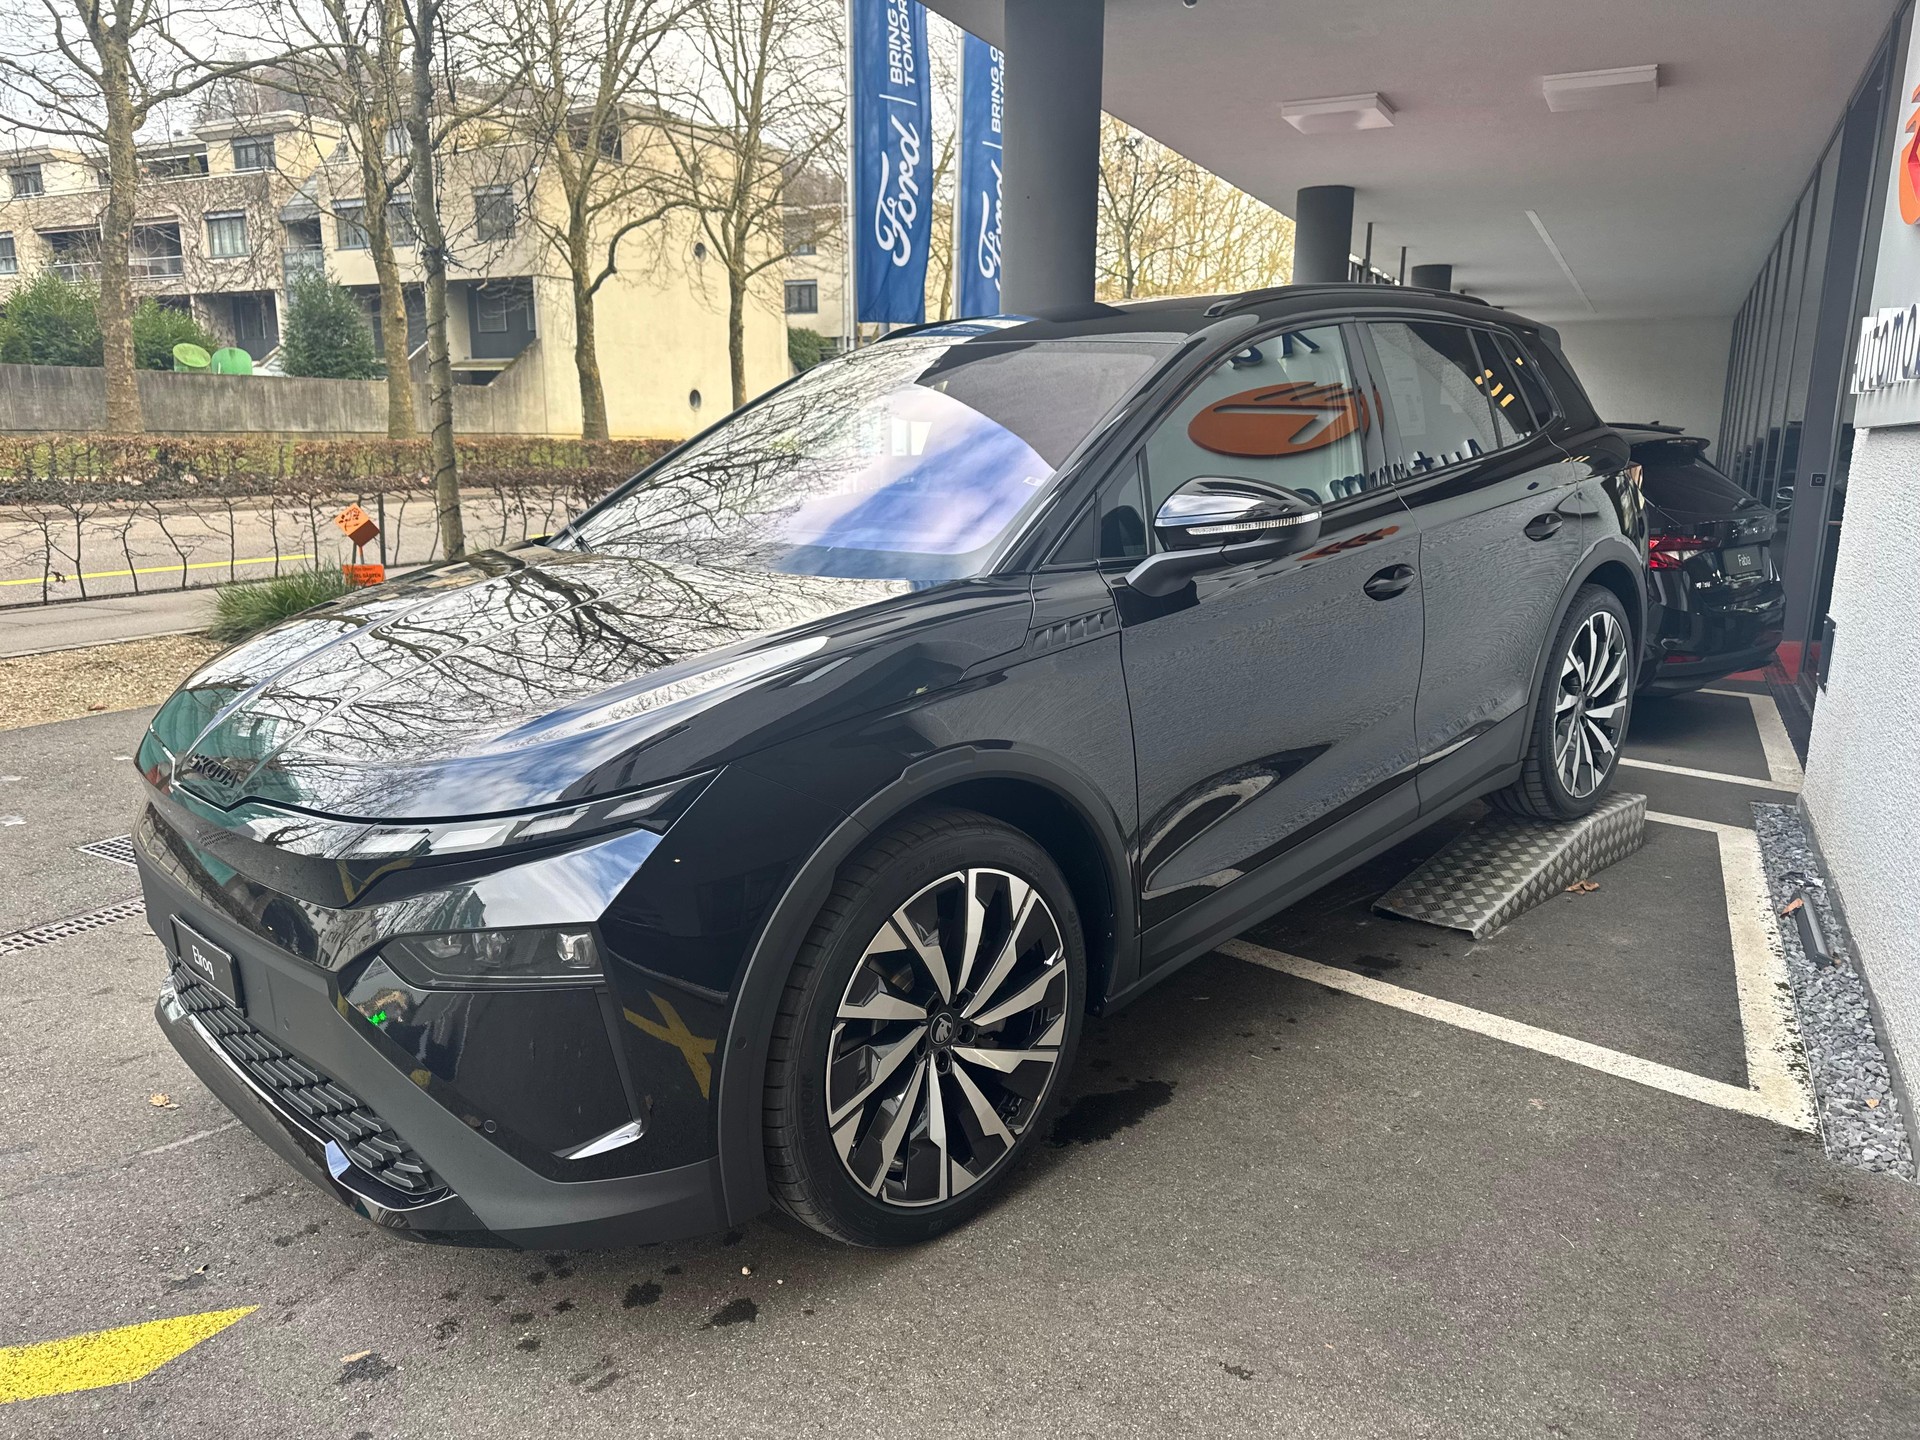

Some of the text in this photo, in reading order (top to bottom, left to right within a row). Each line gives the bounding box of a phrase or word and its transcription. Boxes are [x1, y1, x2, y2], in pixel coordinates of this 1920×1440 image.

[887, 8, 904, 85] BRING
[991, 66, 1001, 133] BRING
[875, 114, 921, 267] Ford
[1852, 303, 1920, 393] utomo
[1737, 553, 1752, 567] Fabia
[191, 944, 215, 981] Elroq
